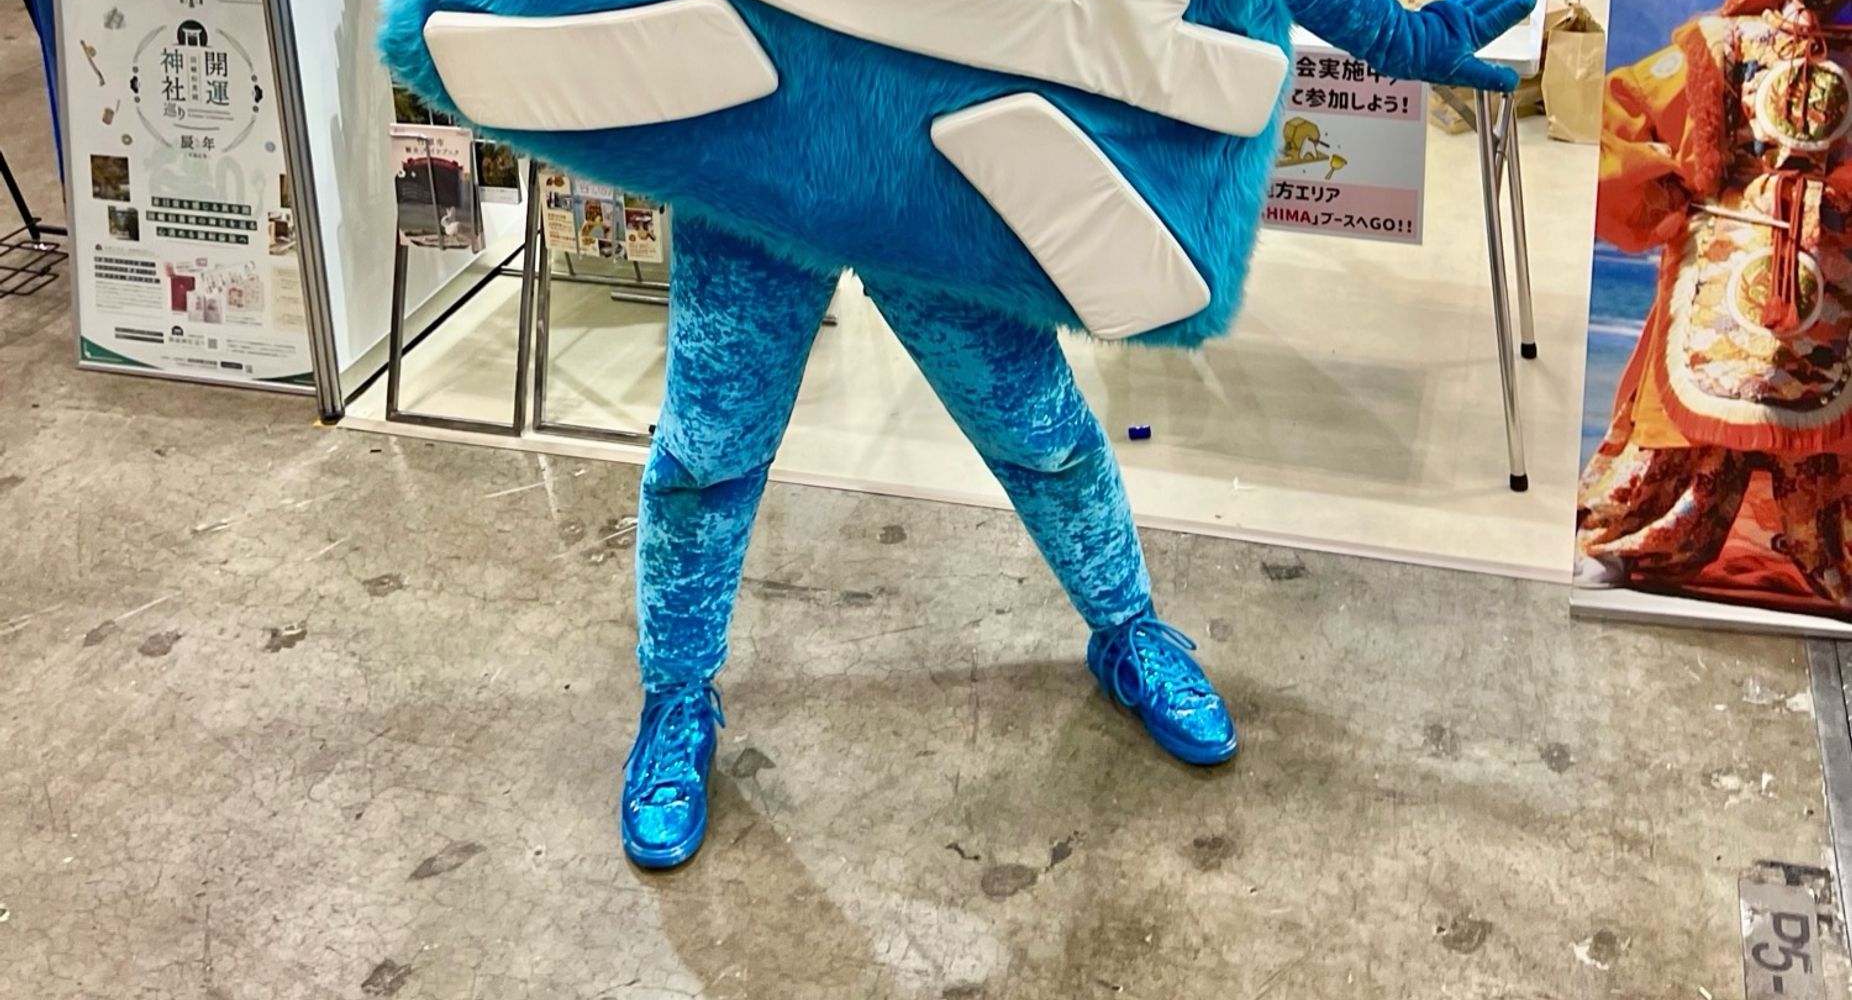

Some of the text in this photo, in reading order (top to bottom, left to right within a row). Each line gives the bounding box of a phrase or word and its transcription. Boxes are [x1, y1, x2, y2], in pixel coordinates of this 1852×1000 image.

[205, 51, 230, 106] 開運
[1261, 206, 1413, 234] HIMA」ブースへGO!!
